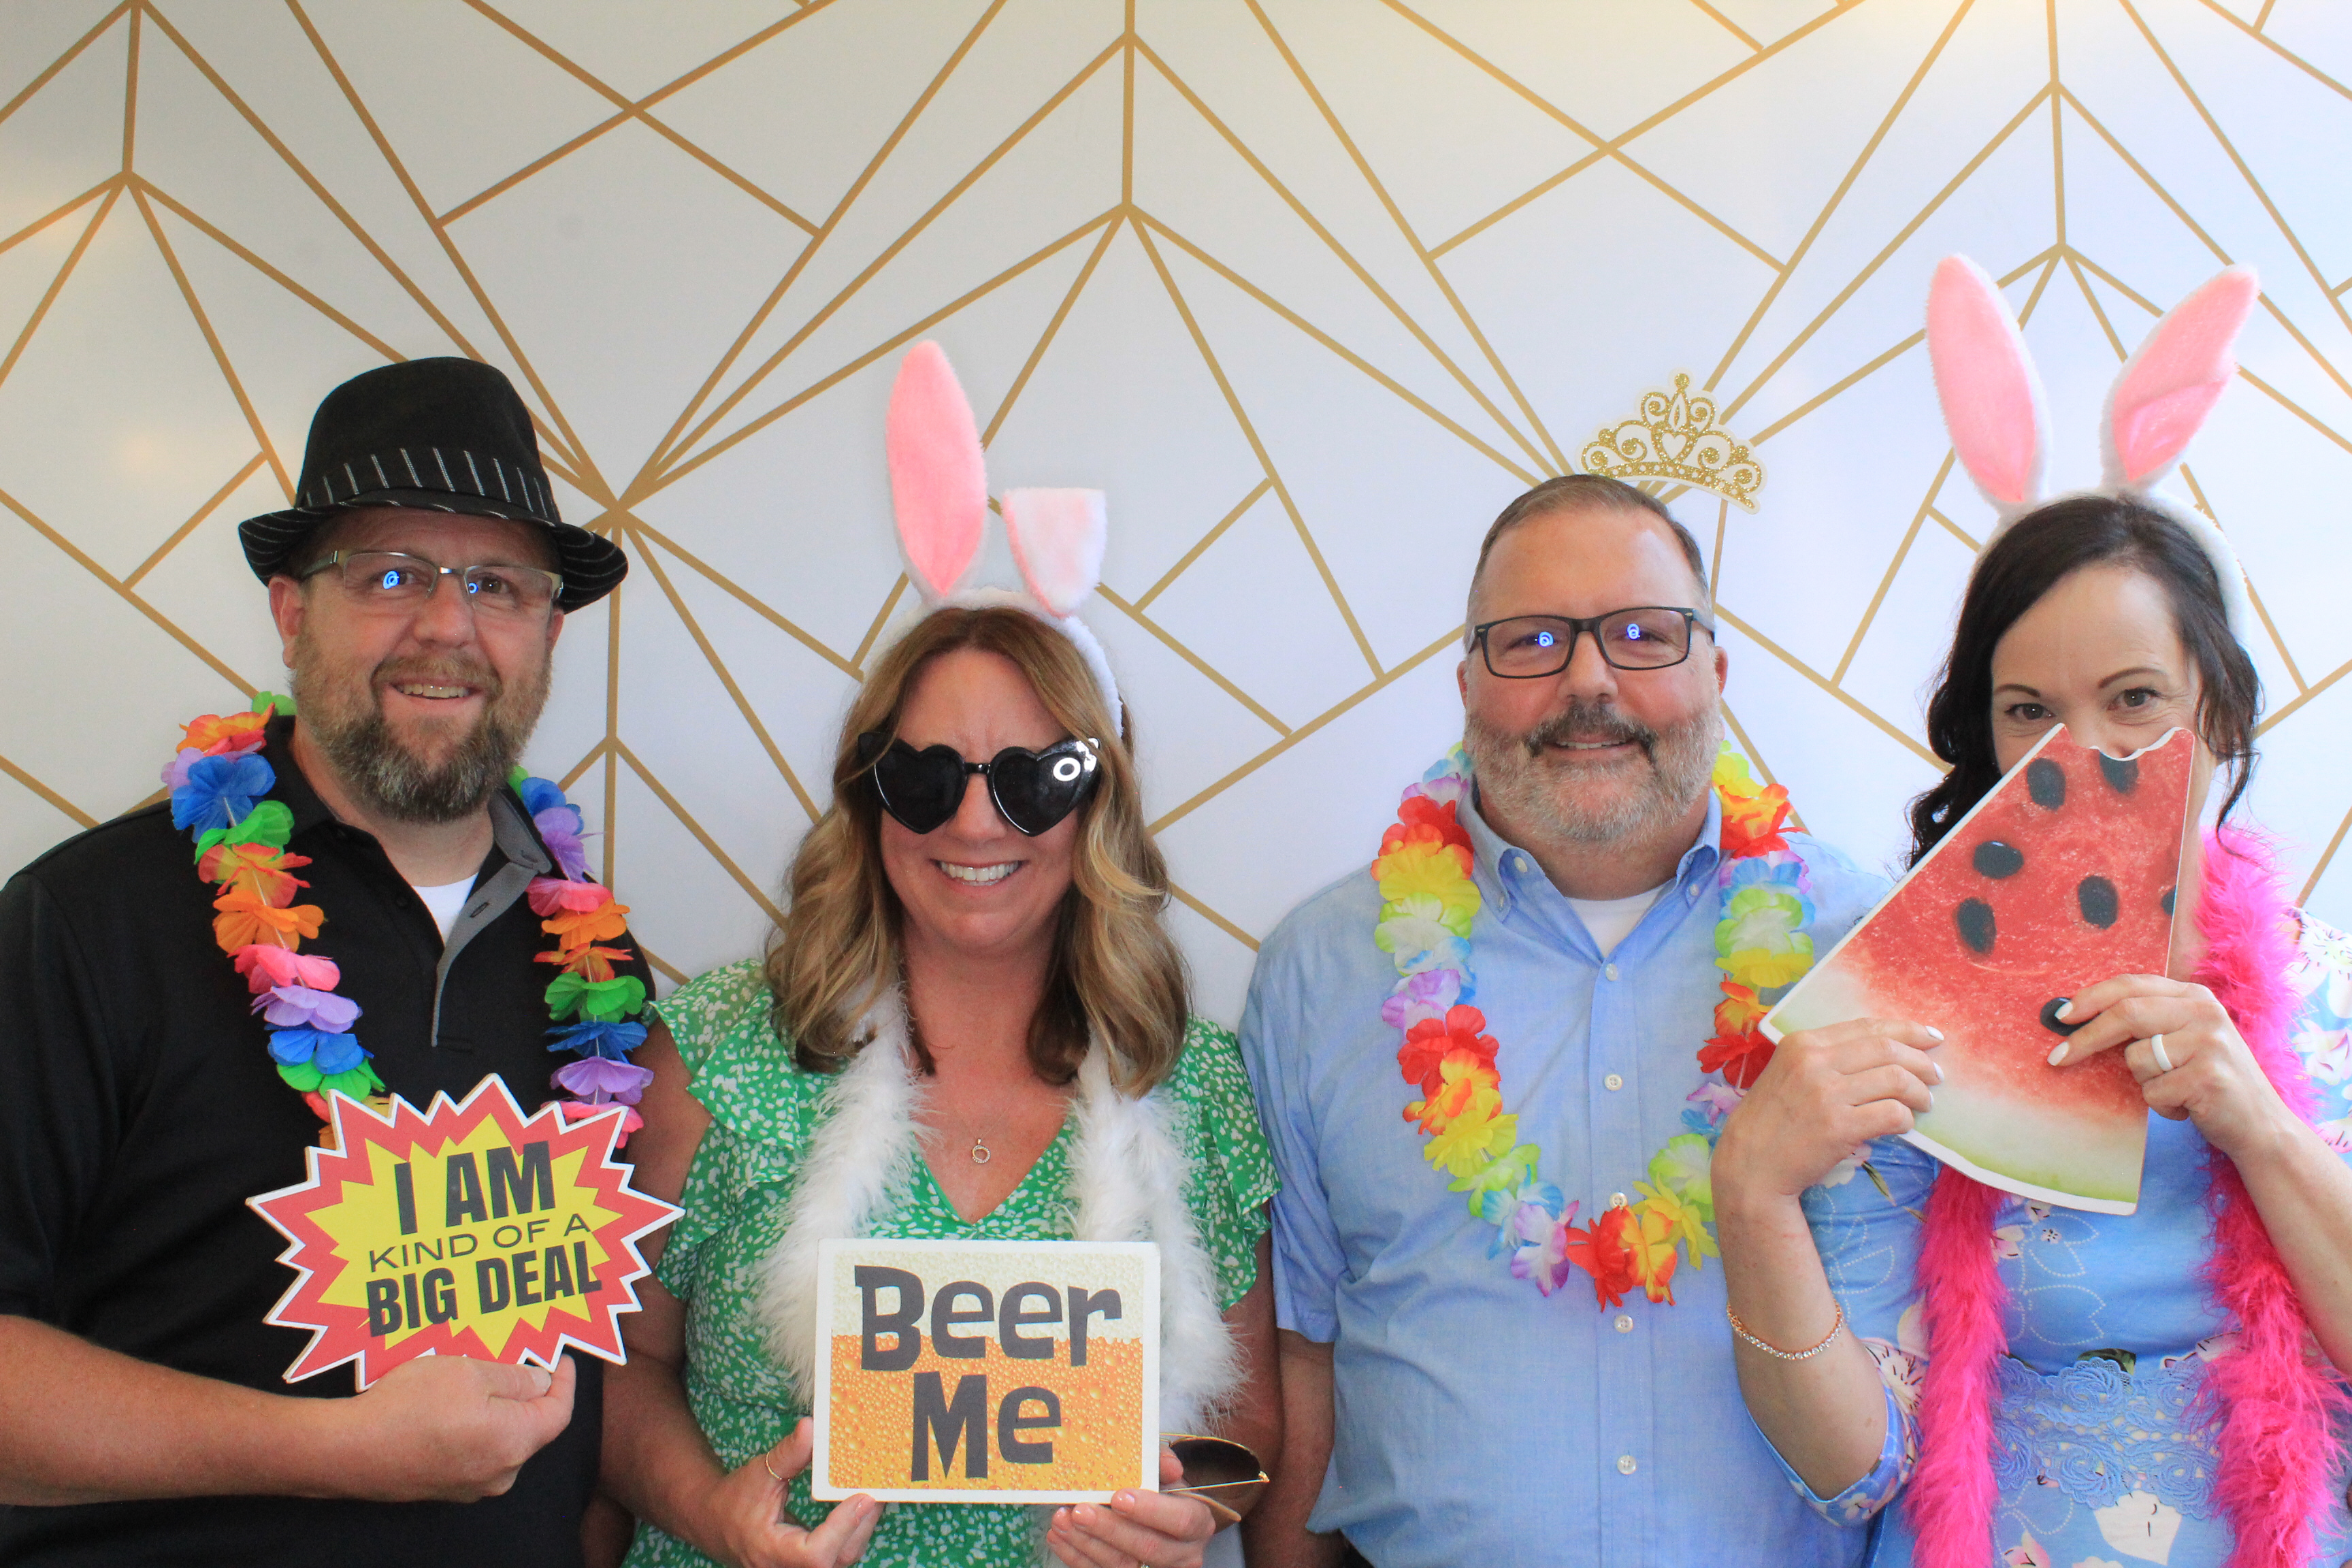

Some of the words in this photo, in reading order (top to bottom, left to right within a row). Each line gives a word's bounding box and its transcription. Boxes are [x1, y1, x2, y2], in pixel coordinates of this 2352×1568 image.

[393, 1162, 418, 1237] I
[445, 1140, 555, 1228] AM
[365, 1267, 458, 1337] BIG
[475, 1241, 603, 1314] DEAL
[369, 1233, 478, 1272] KIND
[493, 1219, 550, 1248] OF
[564, 1213, 591, 1237] A
[853, 1264, 1122, 1372] Beer
[911, 1371, 1062, 1482] Me
